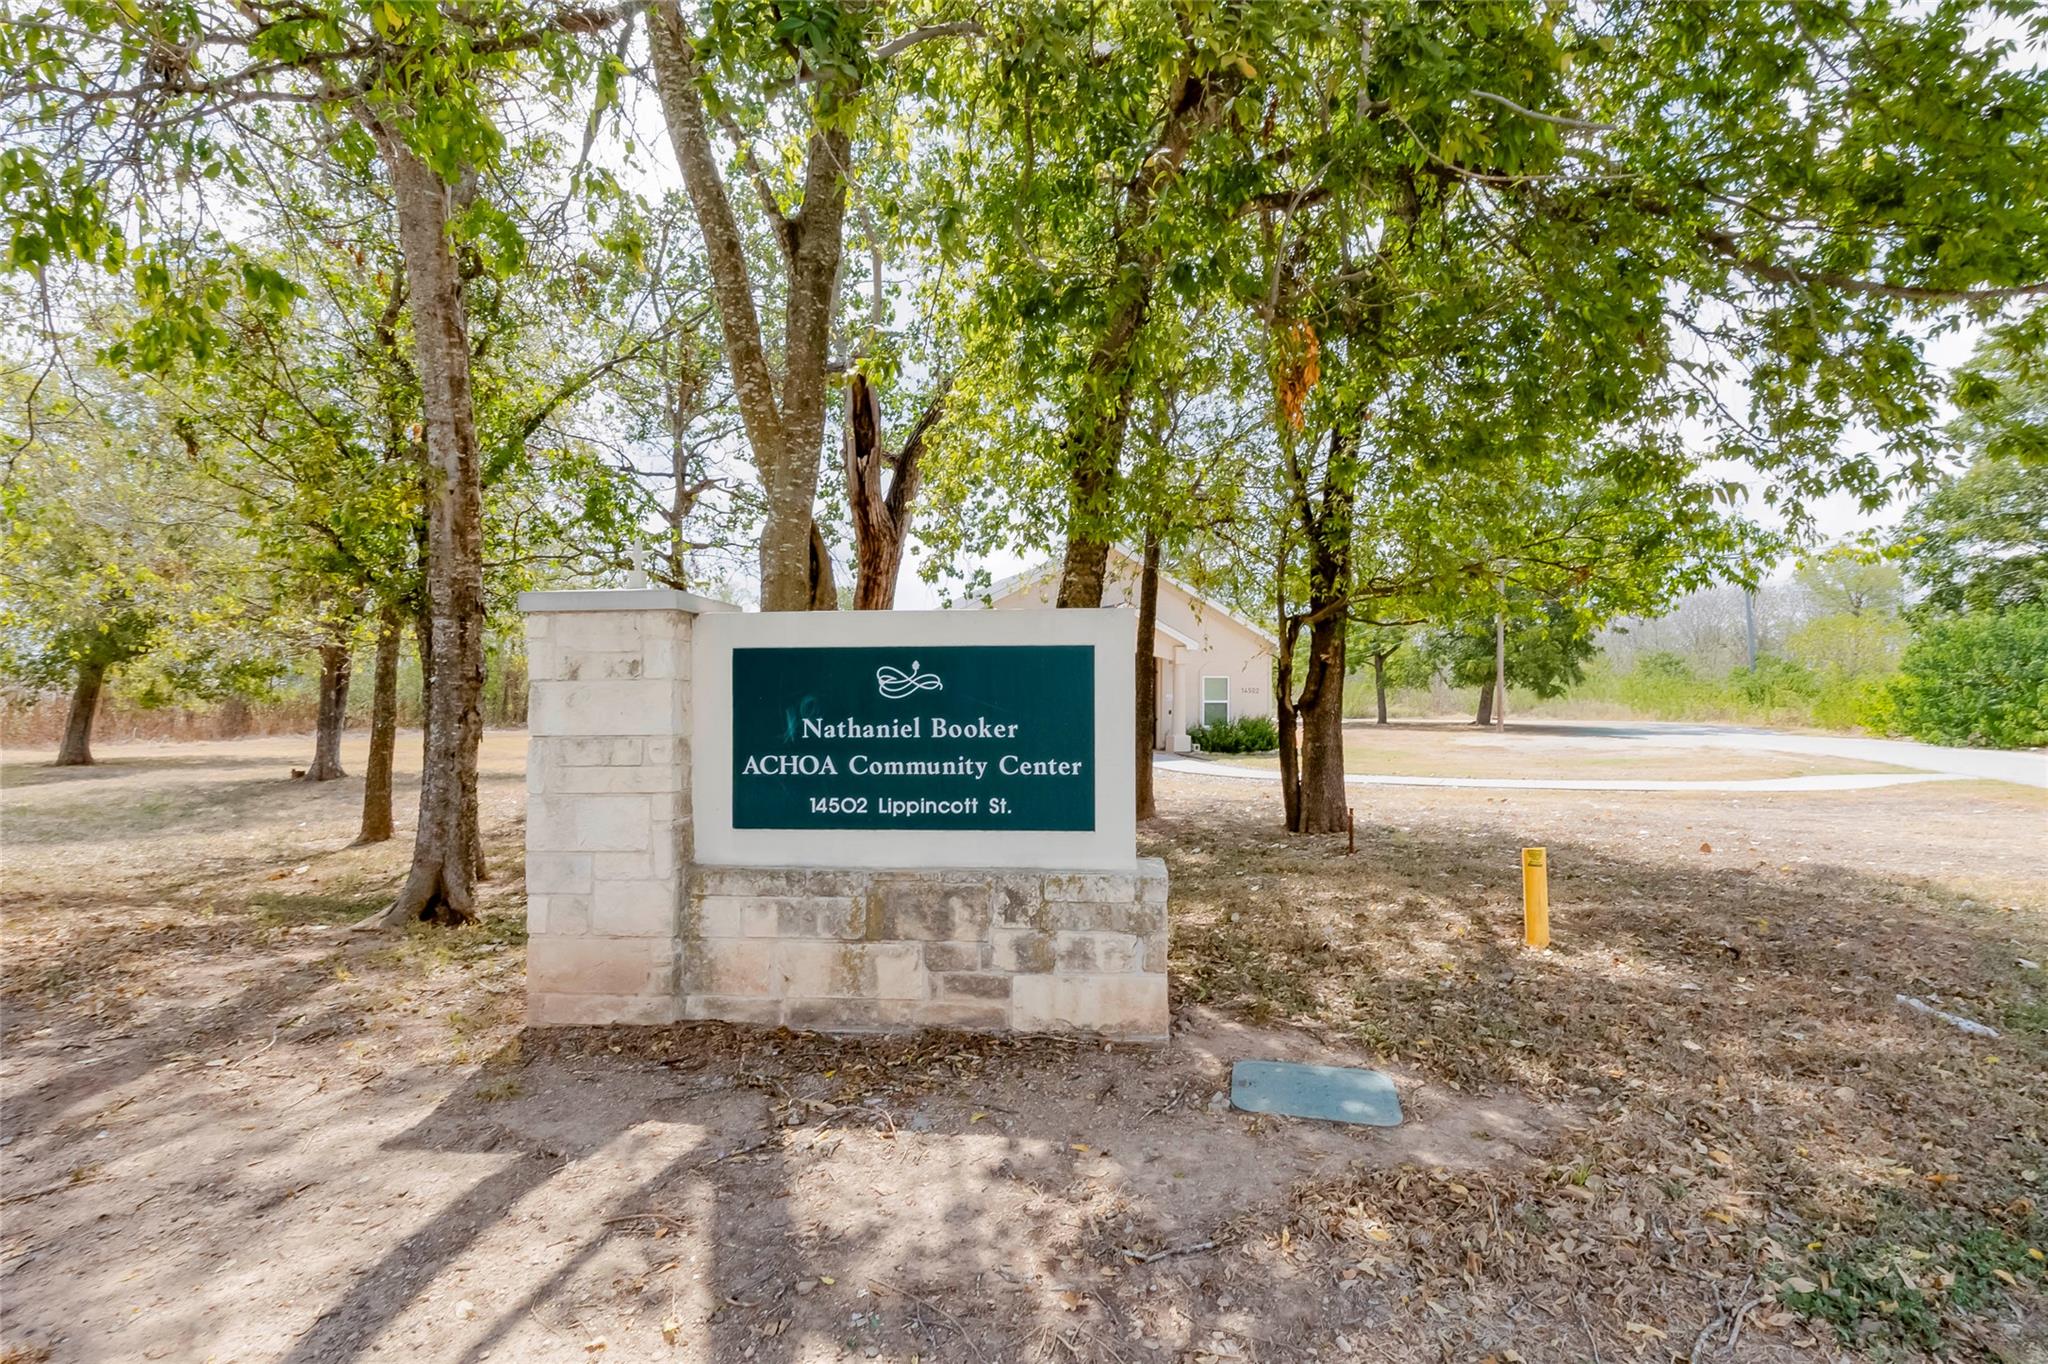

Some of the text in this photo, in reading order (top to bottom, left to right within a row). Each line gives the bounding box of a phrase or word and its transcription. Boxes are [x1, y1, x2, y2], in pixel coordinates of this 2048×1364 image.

[802, 716, 1018, 738] Nathaniel Booker
[742, 755, 1082, 780] ACHOA Community Center
[809, 797, 1012, 817] 14502 Lippincott St.
